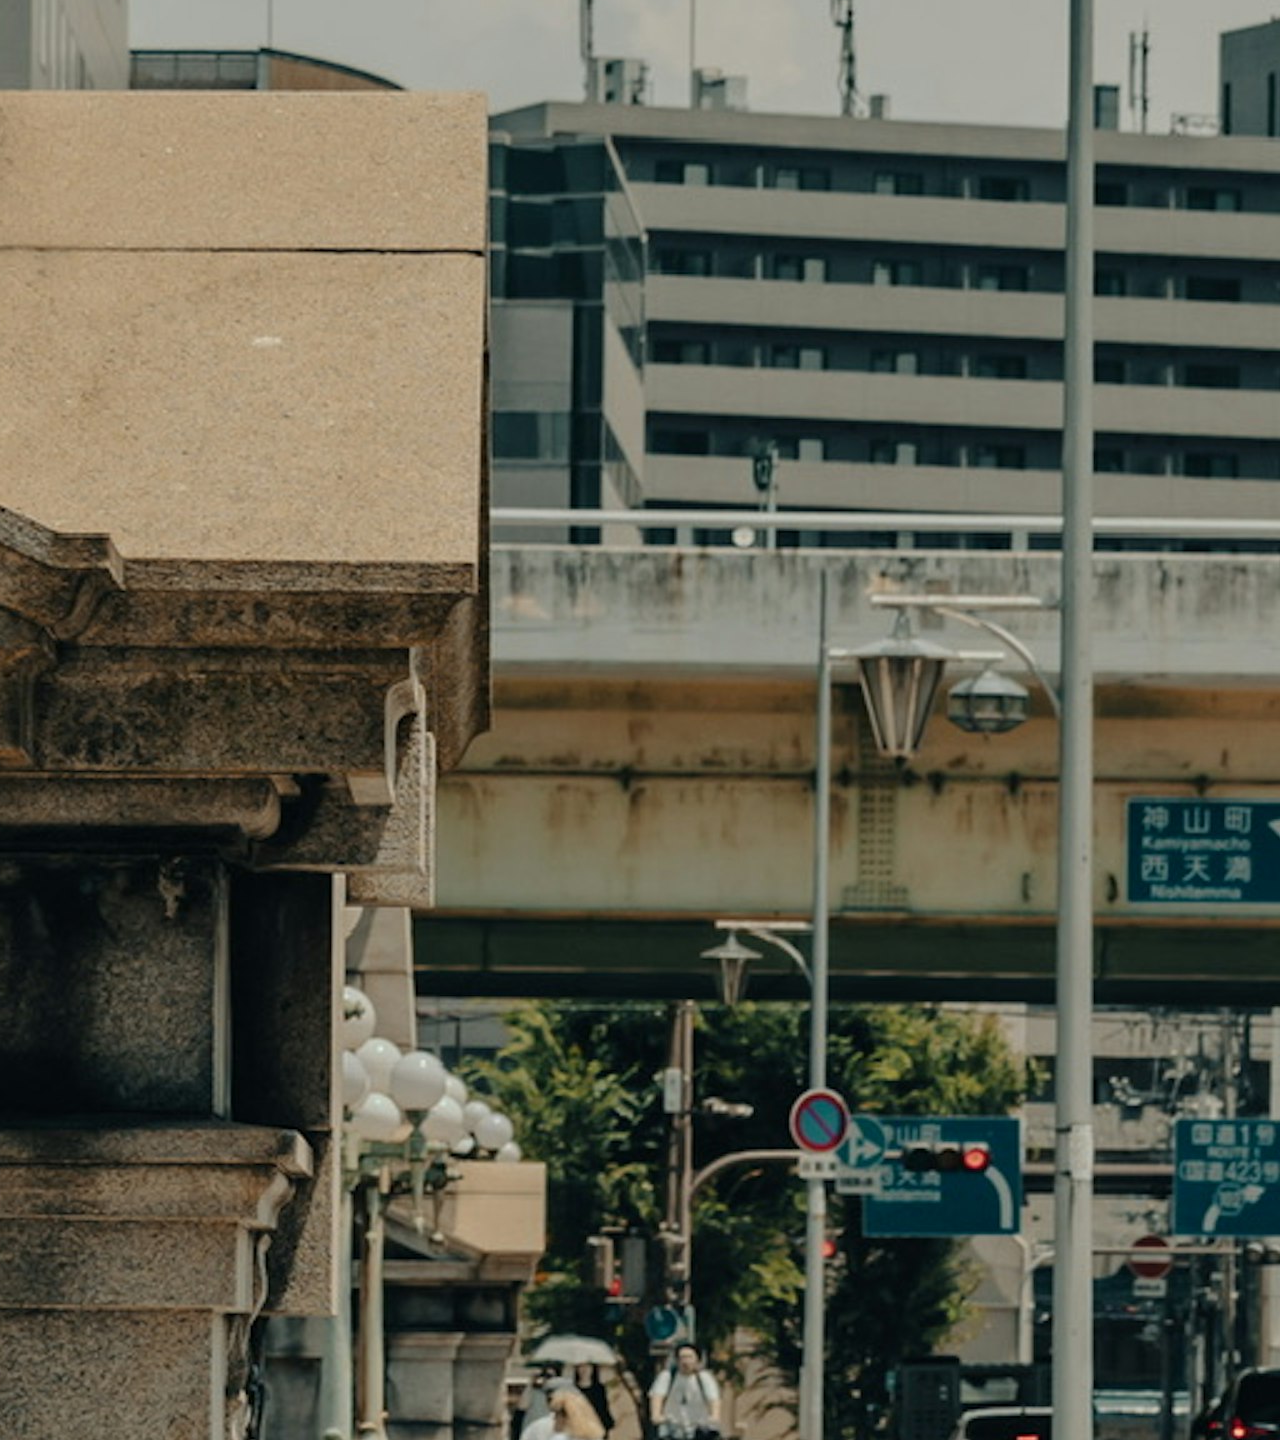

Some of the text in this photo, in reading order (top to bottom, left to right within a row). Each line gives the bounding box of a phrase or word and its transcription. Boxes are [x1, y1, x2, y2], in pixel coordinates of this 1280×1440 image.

[1142, 806, 1252, 834] 神山町
[1142, 835, 1252, 852] Kamiyamacho
[1141, 855, 1252, 882] 西天満
